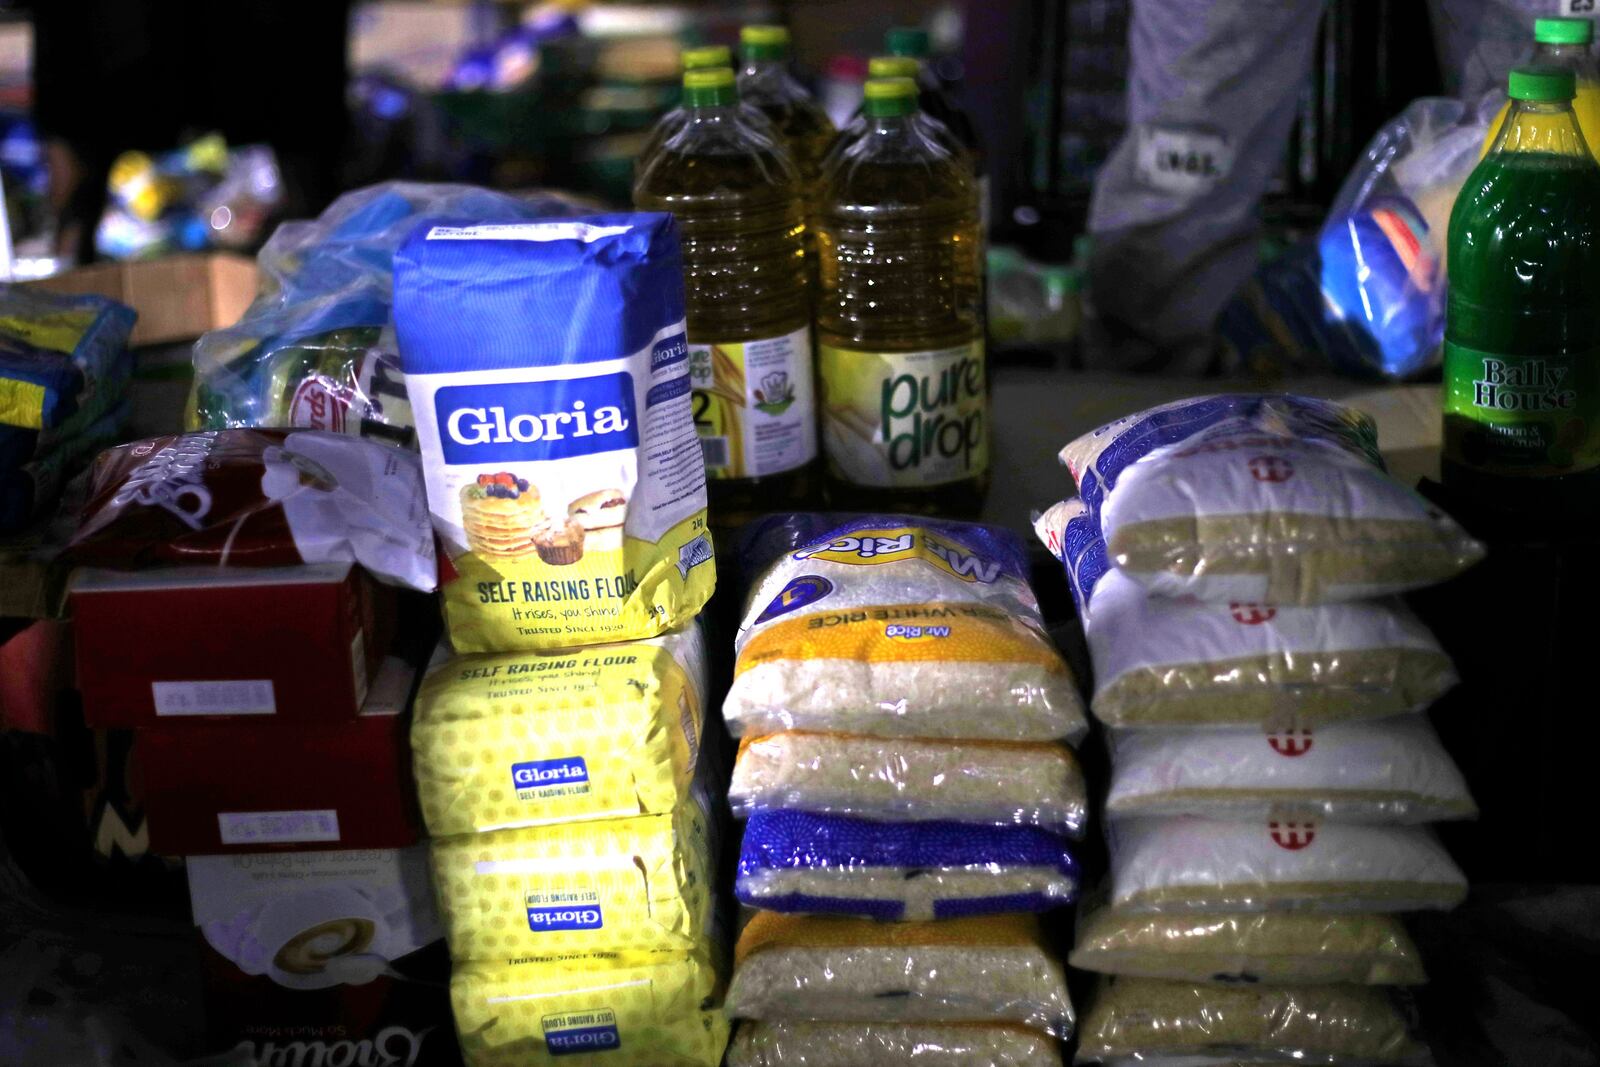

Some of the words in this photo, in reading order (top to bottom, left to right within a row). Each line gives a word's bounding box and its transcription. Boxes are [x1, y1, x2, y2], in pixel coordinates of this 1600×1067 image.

[1482, 358, 1569, 388] Bally
[881, 357, 981, 441] pure
[1473, 380, 1577, 411] House
[447, 401, 629, 447] Gloria
[889, 410, 981, 469] drop
[478, 581, 518, 603] SELF
[523, 579, 590, 602] RAISING
[512, 608, 524, 621] It
[525, 607, 557, 621] rises,
[559, 609, 581, 622] you
[808, 612, 867, 630] RICE
[873, 607, 955, 622] WHITE
[885, 625, 922, 638] Rice
[925, 626, 950, 638] Mr.
[460, 666, 503, 680] SELF
[507, 660, 577, 675] RAISING
[583, 656, 638, 668] FLOUR
[515, 764, 586, 783] Gloria
[519, 791, 535, 800] SELF
[538, 787, 566, 798] RAISING
[568, 785, 589, 795] FLOUR
[527, 894, 549, 904] FLOUR
[550, 893, 578, 903] RAISING
[581, 892, 597, 902] SELF
[530, 910, 599, 925] Gloria
[543, 1017, 566, 1028] FLOUR
[567, 1014, 595, 1026] RAISING
[597, 1012, 613, 1023] SELF
[549, 1031, 616, 1048] Gloria
